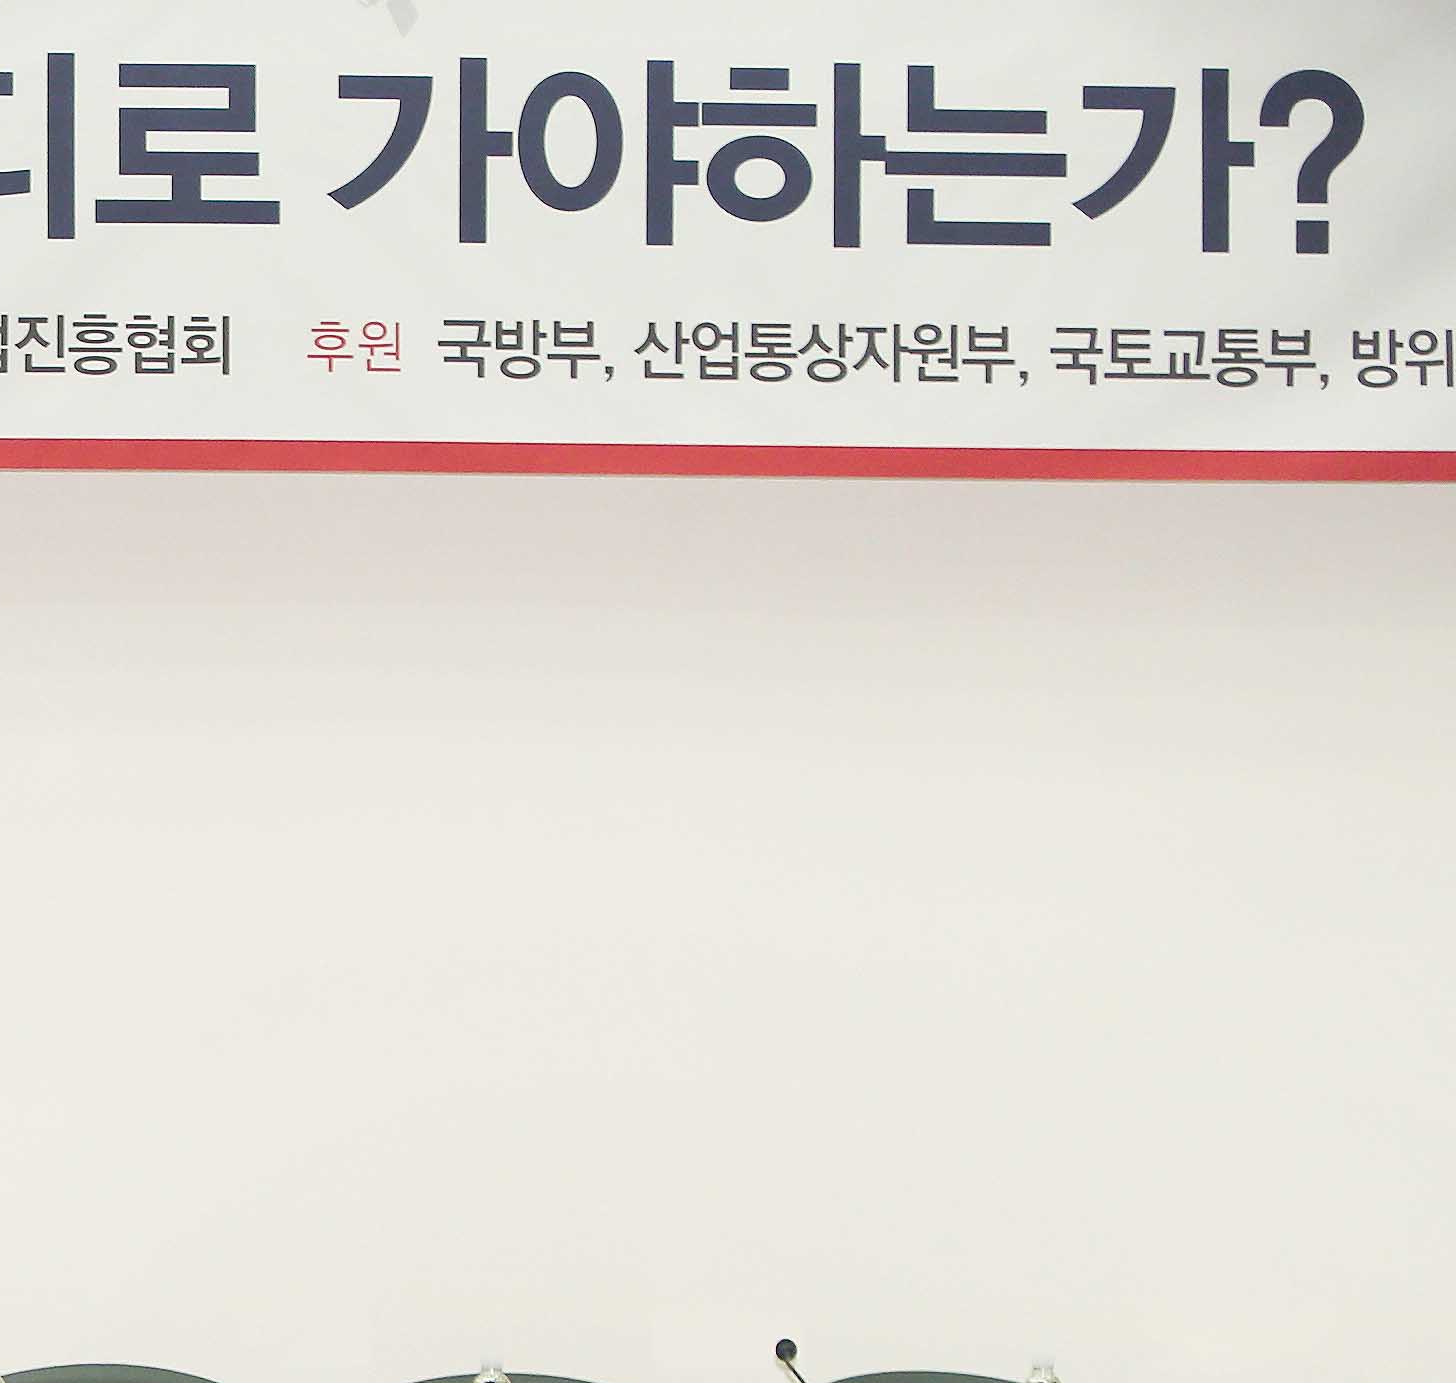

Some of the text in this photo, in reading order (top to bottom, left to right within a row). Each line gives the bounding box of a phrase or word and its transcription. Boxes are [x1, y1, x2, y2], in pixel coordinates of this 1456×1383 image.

[326, 57, 1365, 255] 가야하는가?
[307, 321, 401, 372] 후원
[437, 319, 615, 383] 국방부,
[633, 321, 1029, 387] 산업통상자원부,
[1049, 327, 1329, 391] 국토교통부,
